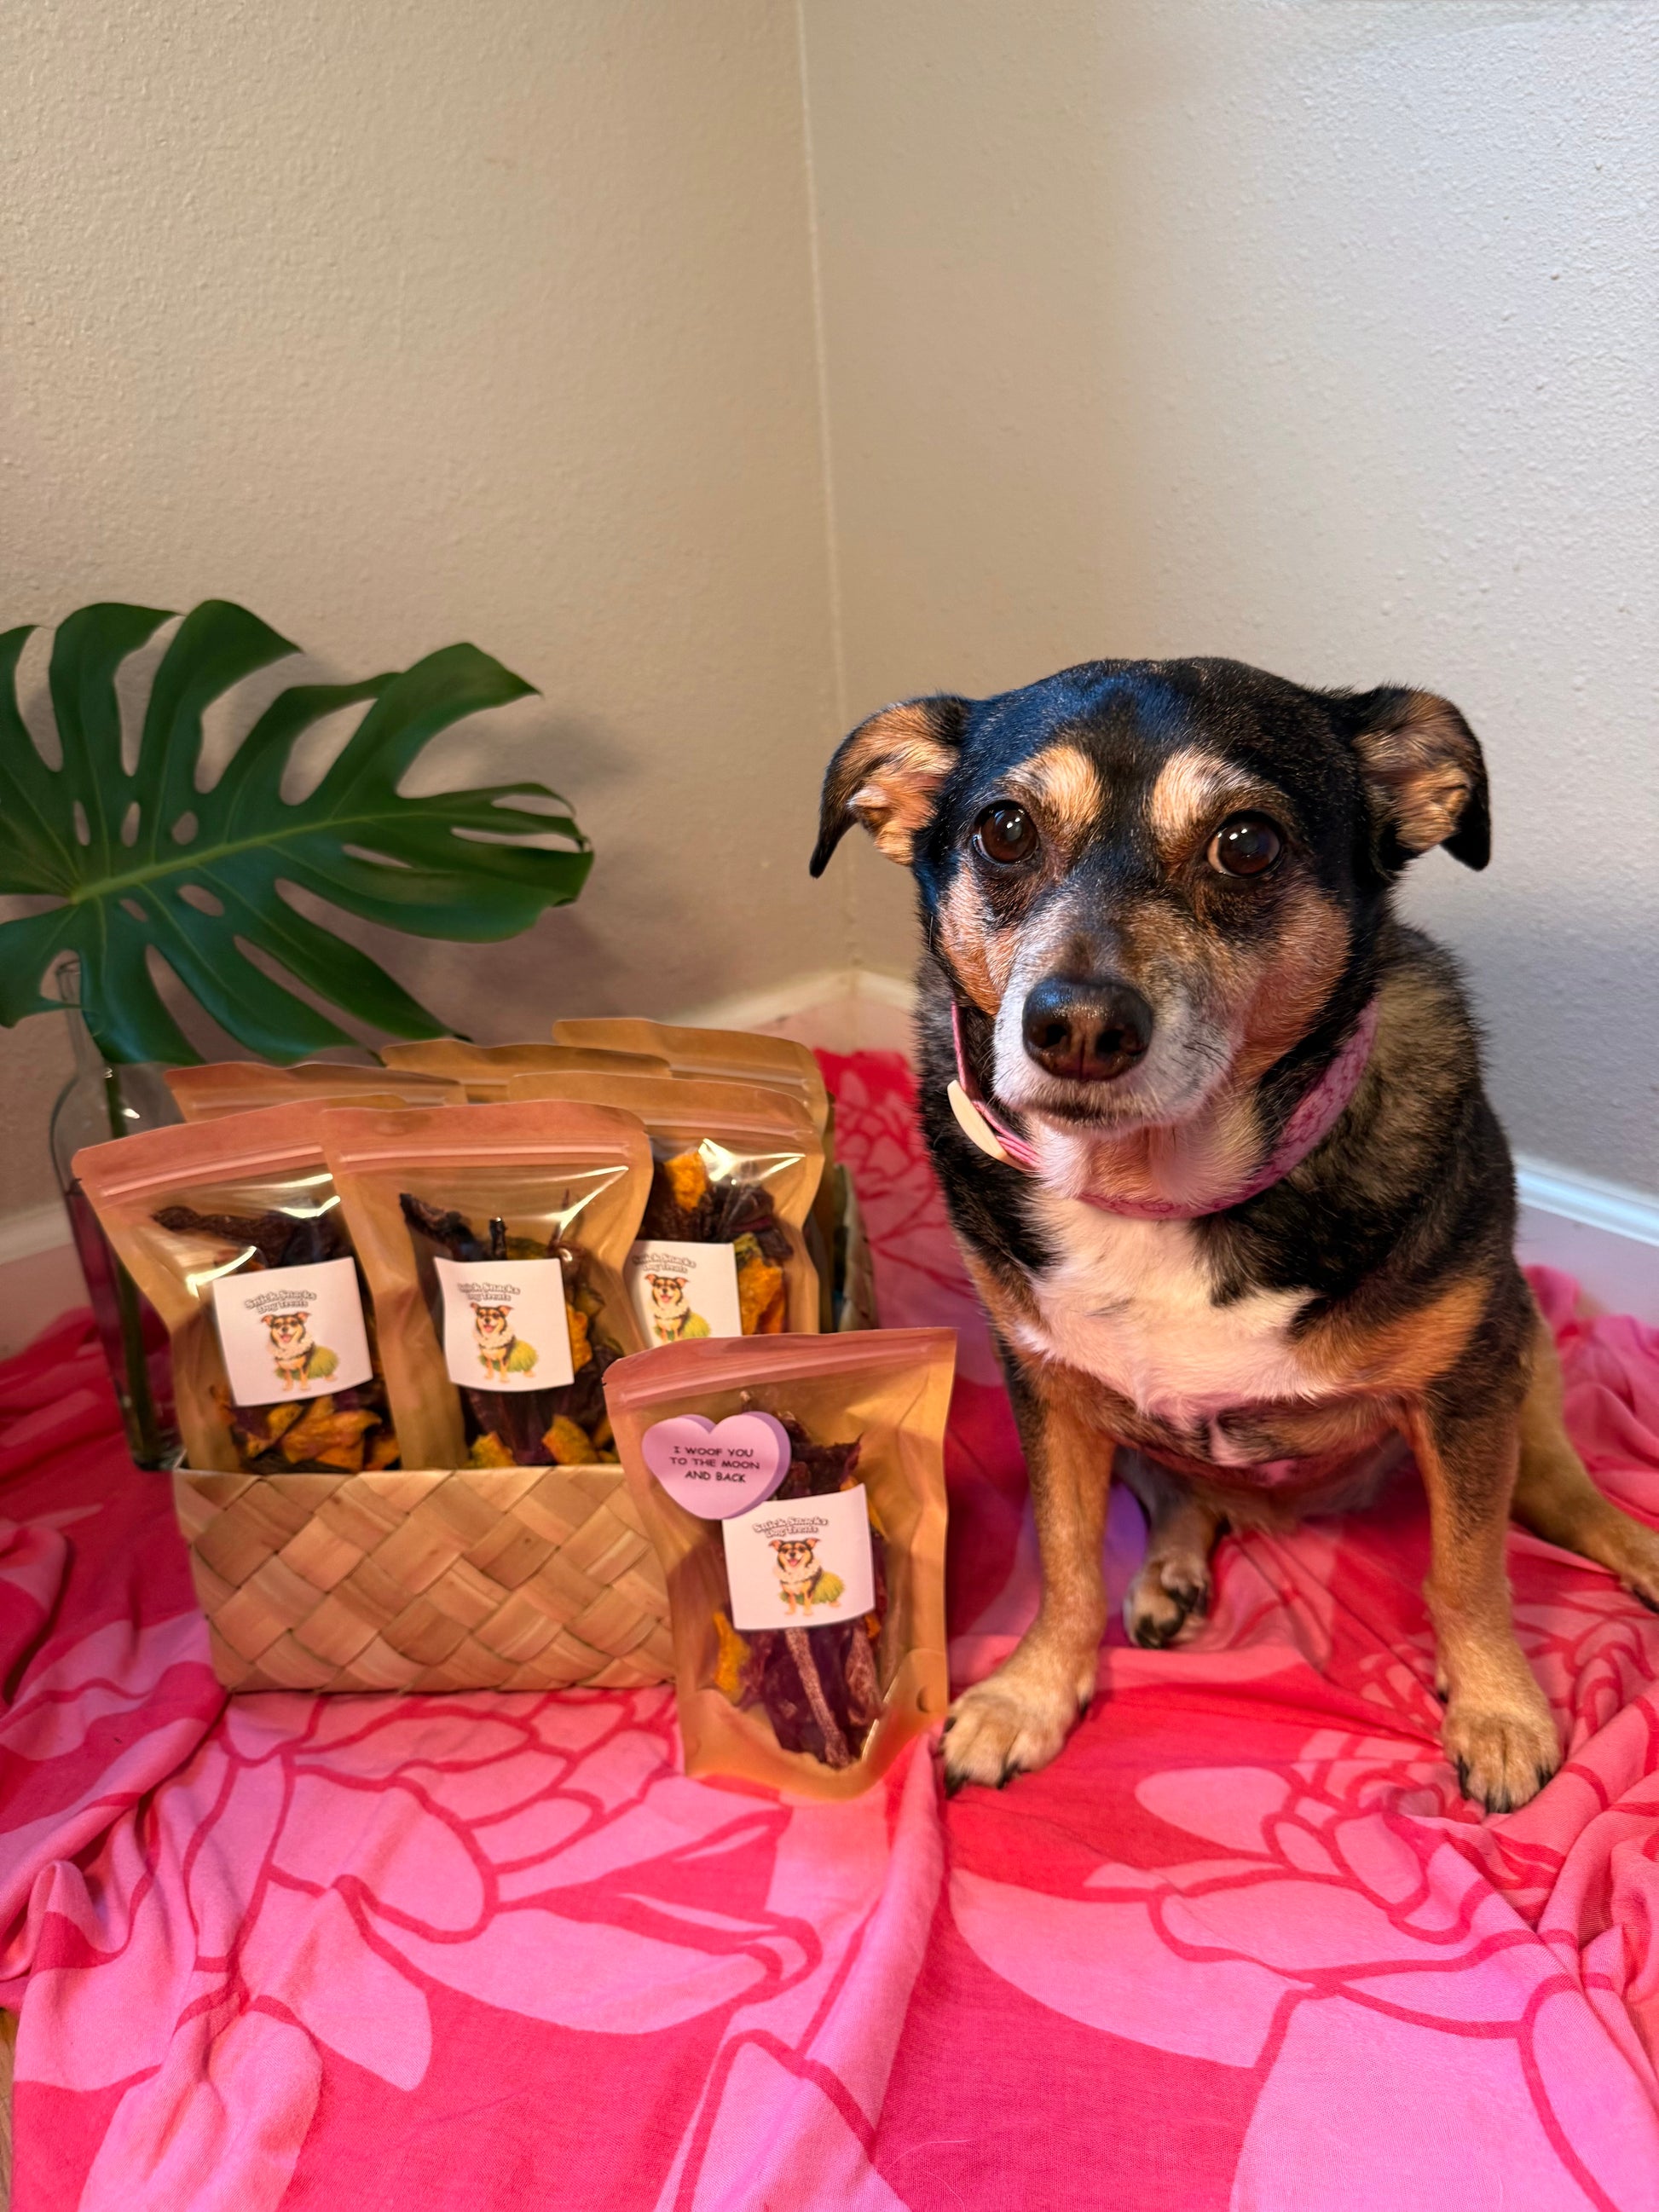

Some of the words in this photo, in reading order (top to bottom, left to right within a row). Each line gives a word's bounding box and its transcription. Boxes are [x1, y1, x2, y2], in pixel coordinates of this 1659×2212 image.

[662, 1252, 697, 1268] Snacks
[482, 1282, 521, 1296] Snacks
[279, 1290, 317, 1301] Snacks
[685, 1447, 722, 1456] WOOF
[727, 1448, 754, 1458] YOU
[669, 1457, 687, 1465] TO
[692, 1458, 716, 1467] THE
[721, 1460, 760, 1470] MOON
[685, 1470, 711, 1481] AND
[715, 1471, 746, 1482] BACK
[787, 1516, 829, 1527] Snacks
